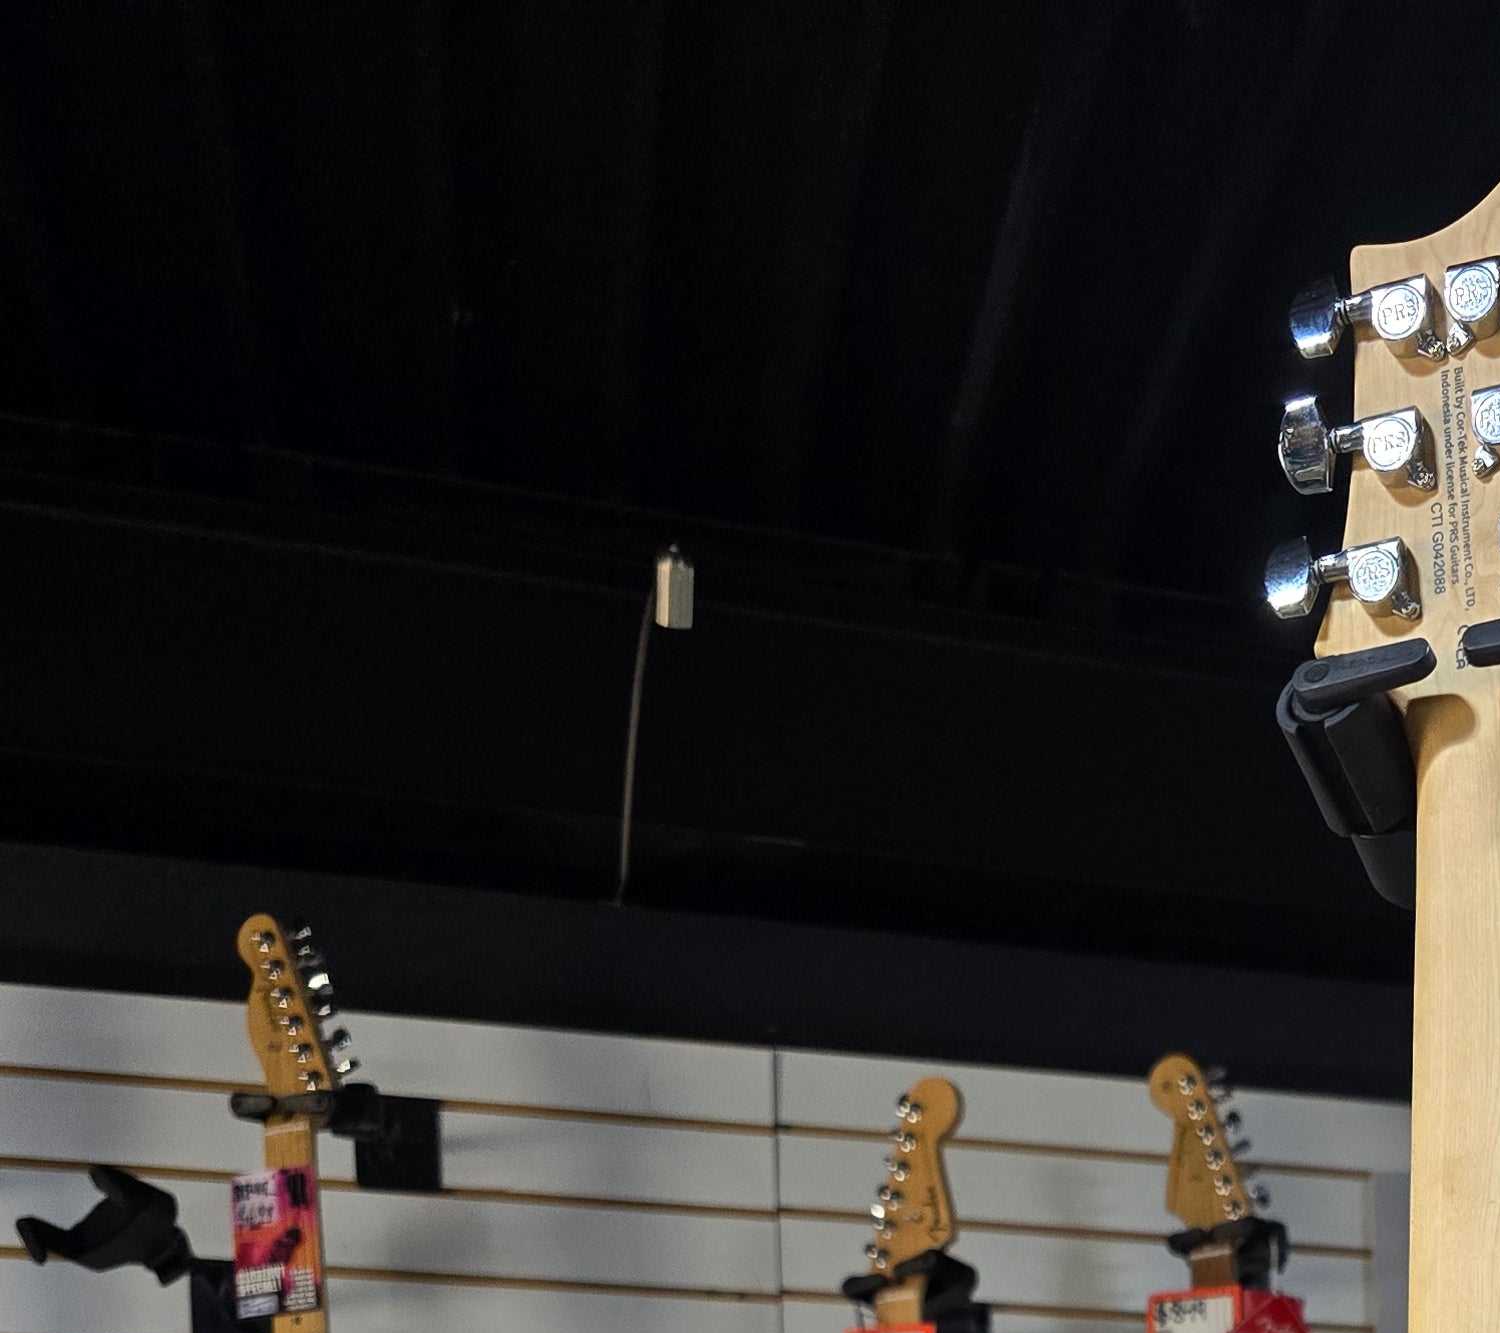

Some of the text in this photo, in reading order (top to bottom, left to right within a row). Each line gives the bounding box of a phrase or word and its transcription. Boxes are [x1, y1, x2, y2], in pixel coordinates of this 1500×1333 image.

[1382, 293, 1417, 325] PRS
[1454, 366, 1464, 395] Built
[1454, 396, 1464, 409] by
[1456, 411, 1468, 455] Cor-Tek
[1441, 369, 1460, 585] Indonesia under license for PRS Guitars
[1459, 456, 1470, 497] Musical
[1431, 502, 1446, 595] CTI G042088
[1460, 499, 1472, 560] Instrument
